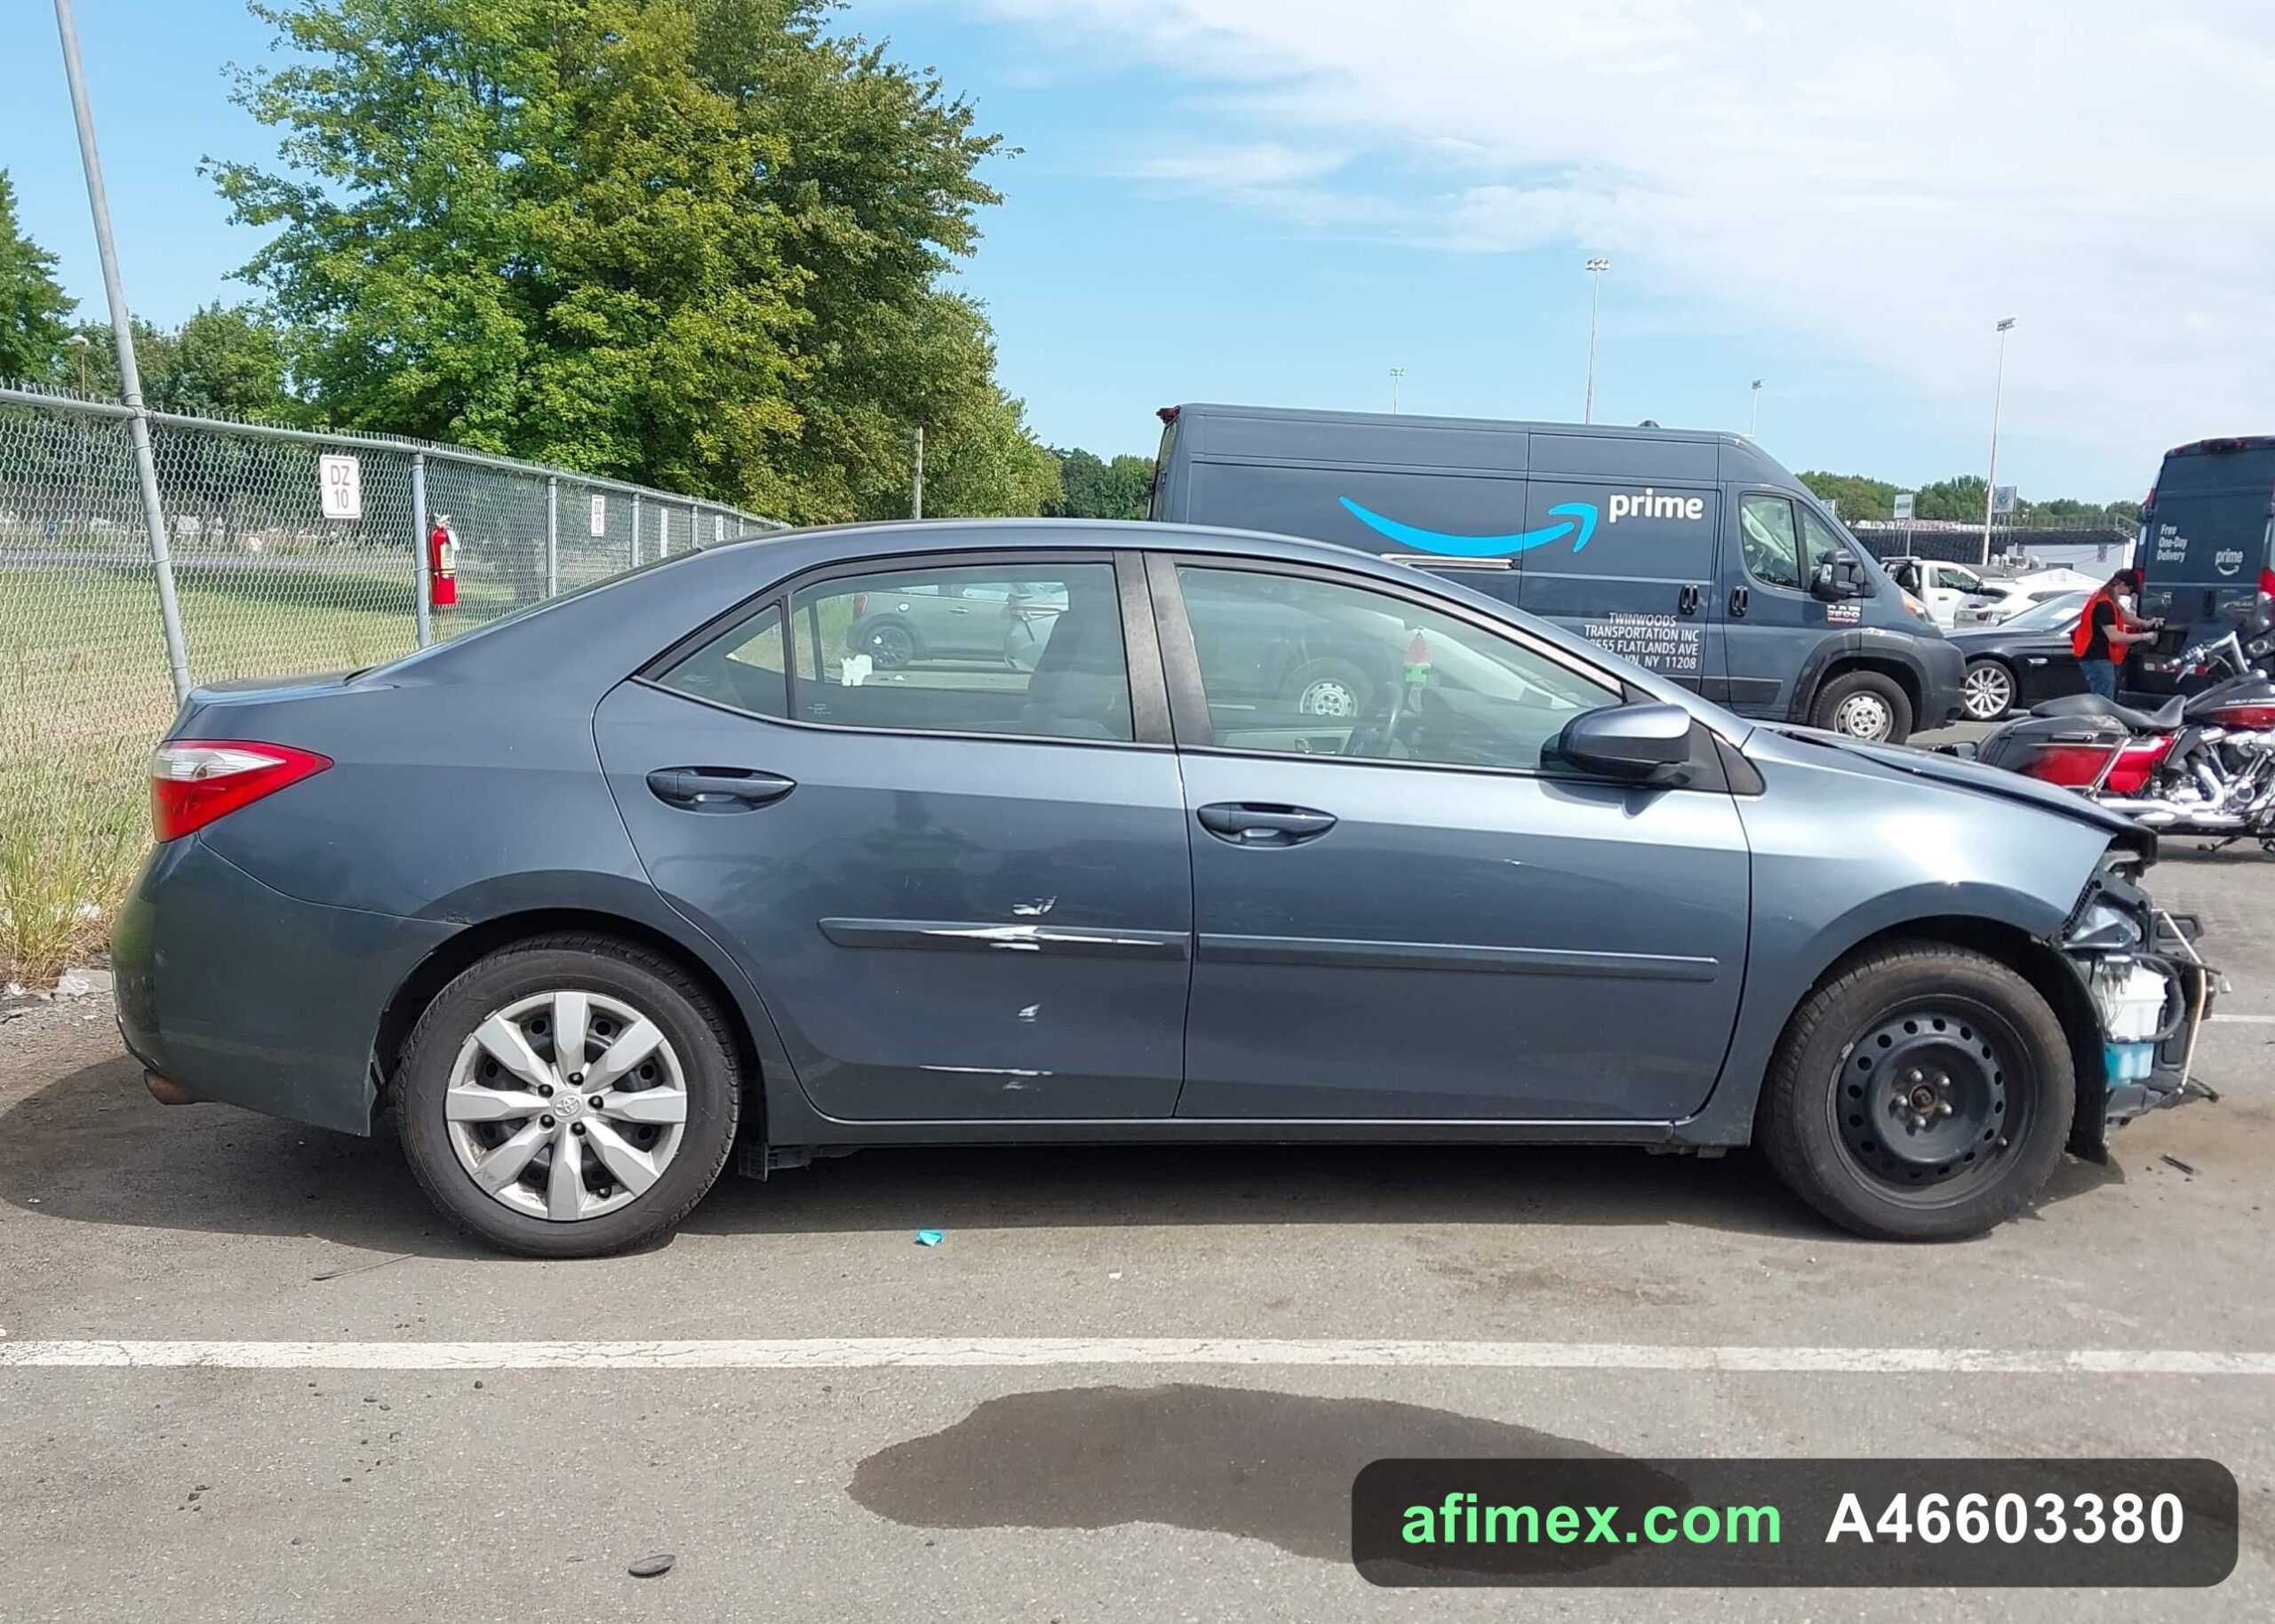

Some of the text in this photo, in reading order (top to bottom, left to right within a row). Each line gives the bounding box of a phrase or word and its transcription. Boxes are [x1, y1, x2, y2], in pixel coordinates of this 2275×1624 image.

[331, 465, 350, 486] DZ
[333, 489, 349, 509] 10
[1608, 488, 1704, 523] prime
[2160, 523, 2177, 535] Free
[2158, 536, 2188, 550] One-Day
[2156, 549, 2186, 563] Delivery
[2215, 547, 2244, 566] prime
[1608, 612, 1677, 627] TWINWOODS
[1585, 624, 1699, 642] TRANSPORTATION INC
[1617, 640, 1676, 655] FLATLANDS
[1678, 643, 1699, 656] AVE
[1644, 655, 1660, 668] NY
[1665, 657, 1697, 670] 11208
